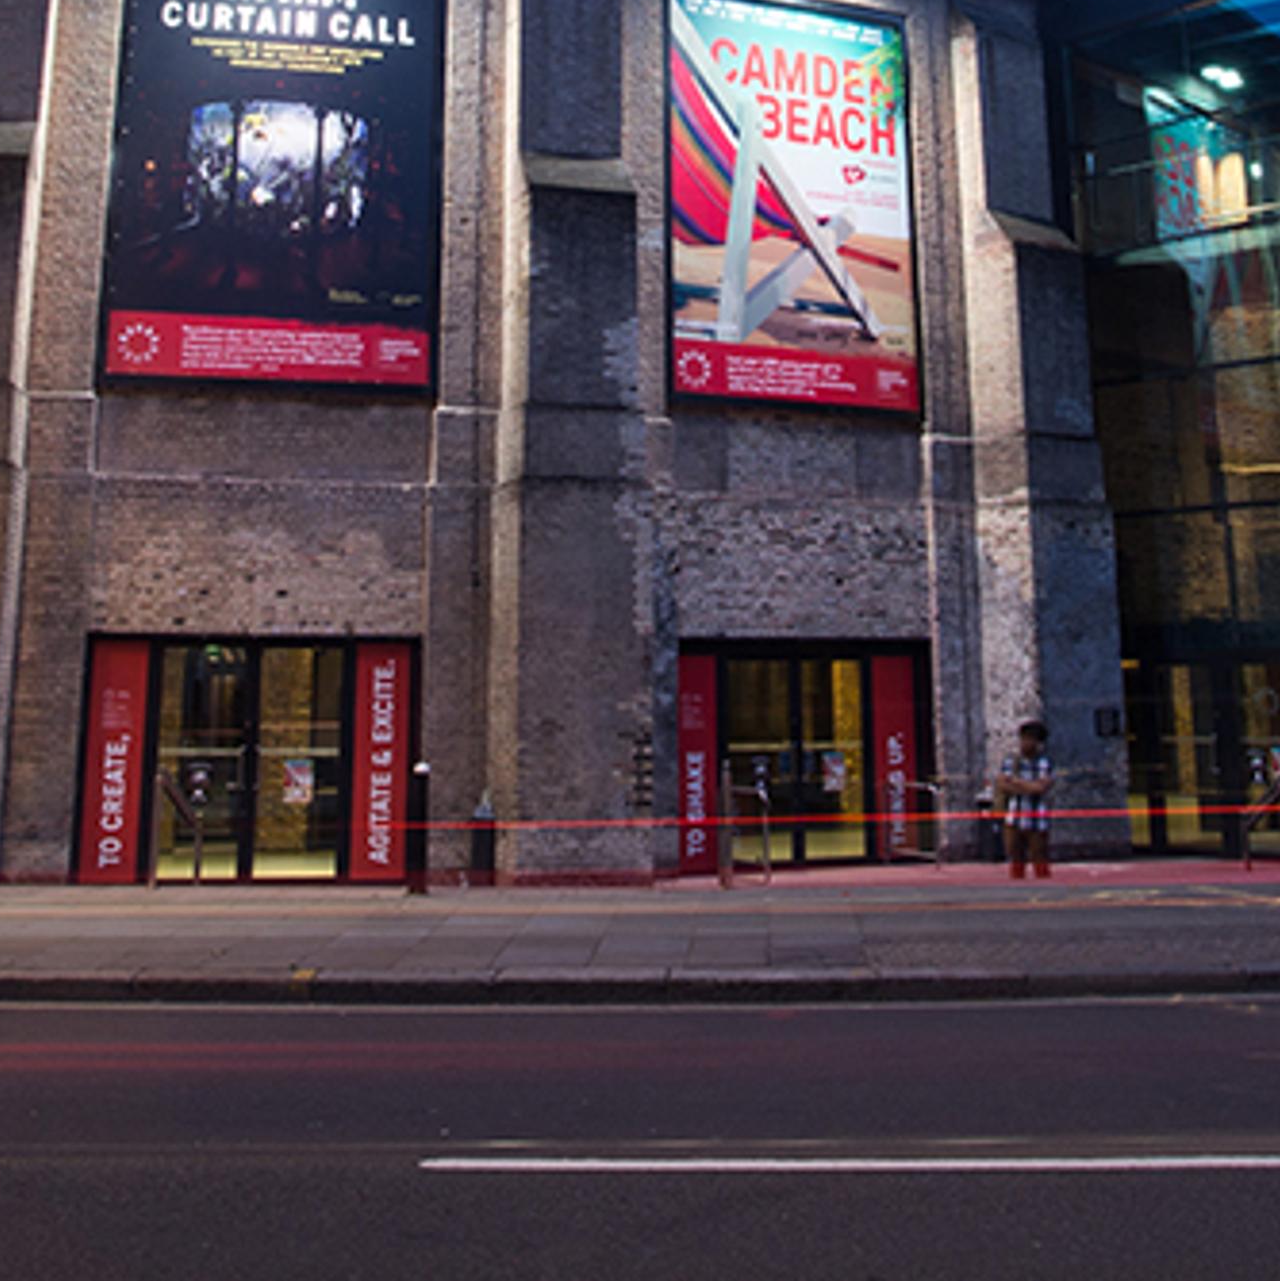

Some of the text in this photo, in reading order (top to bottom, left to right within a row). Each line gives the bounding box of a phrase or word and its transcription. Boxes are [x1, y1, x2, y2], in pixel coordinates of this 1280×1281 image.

[160, 0, 416, 47] CURTAIN CALL
[709, 36, 894, 108] CAMDEN
[754, 93, 896, 158] BEACH
[371, 658, 396, 743] EXCITE.
[99, 733, 131, 832] CREATE,
[367, 772, 393, 865] AGITATE
[685, 751, 706, 823] SHAKE
[98, 836, 122, 868] TO
[685, 828, 706, 856] TO
